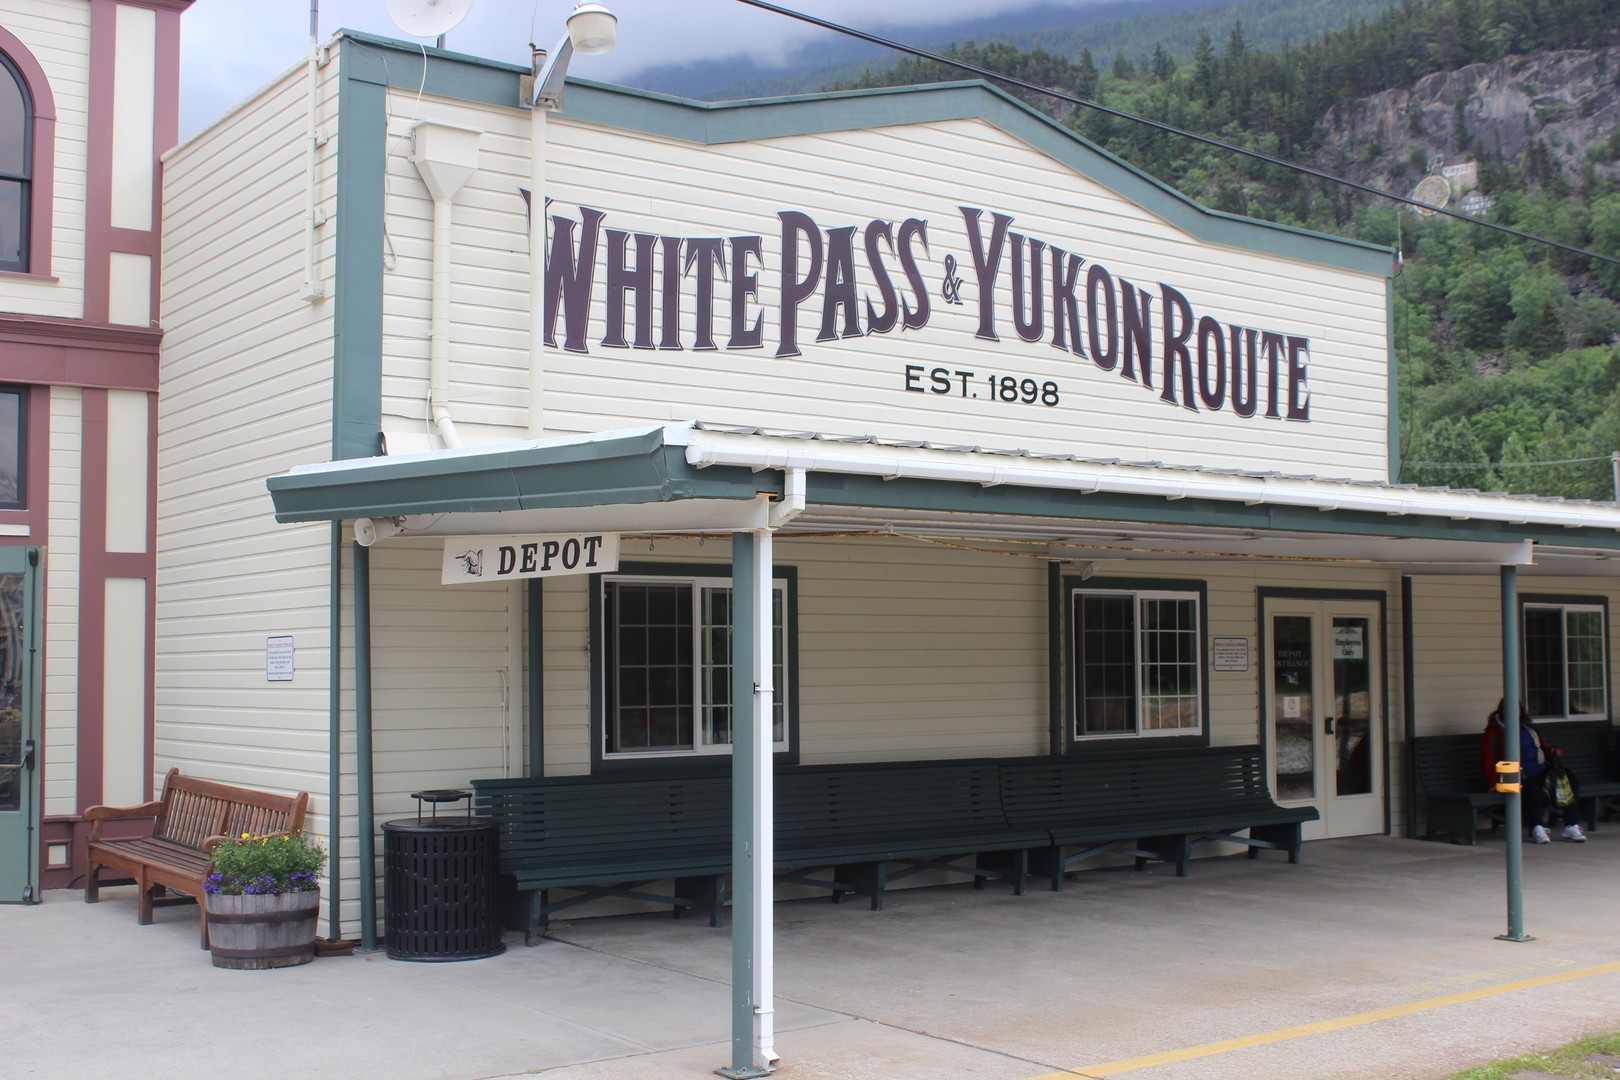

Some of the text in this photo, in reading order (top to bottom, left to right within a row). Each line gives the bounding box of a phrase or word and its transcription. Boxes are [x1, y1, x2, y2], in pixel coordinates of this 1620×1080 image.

[518, 186, 1311, 422] WHITE PASS & YUKON ROUTE
[904, 364, 1060, 407] EST. 1898
[497, 535, 602, 576] DEPOT
[1278, 650, 1303, 658] DEPOT
